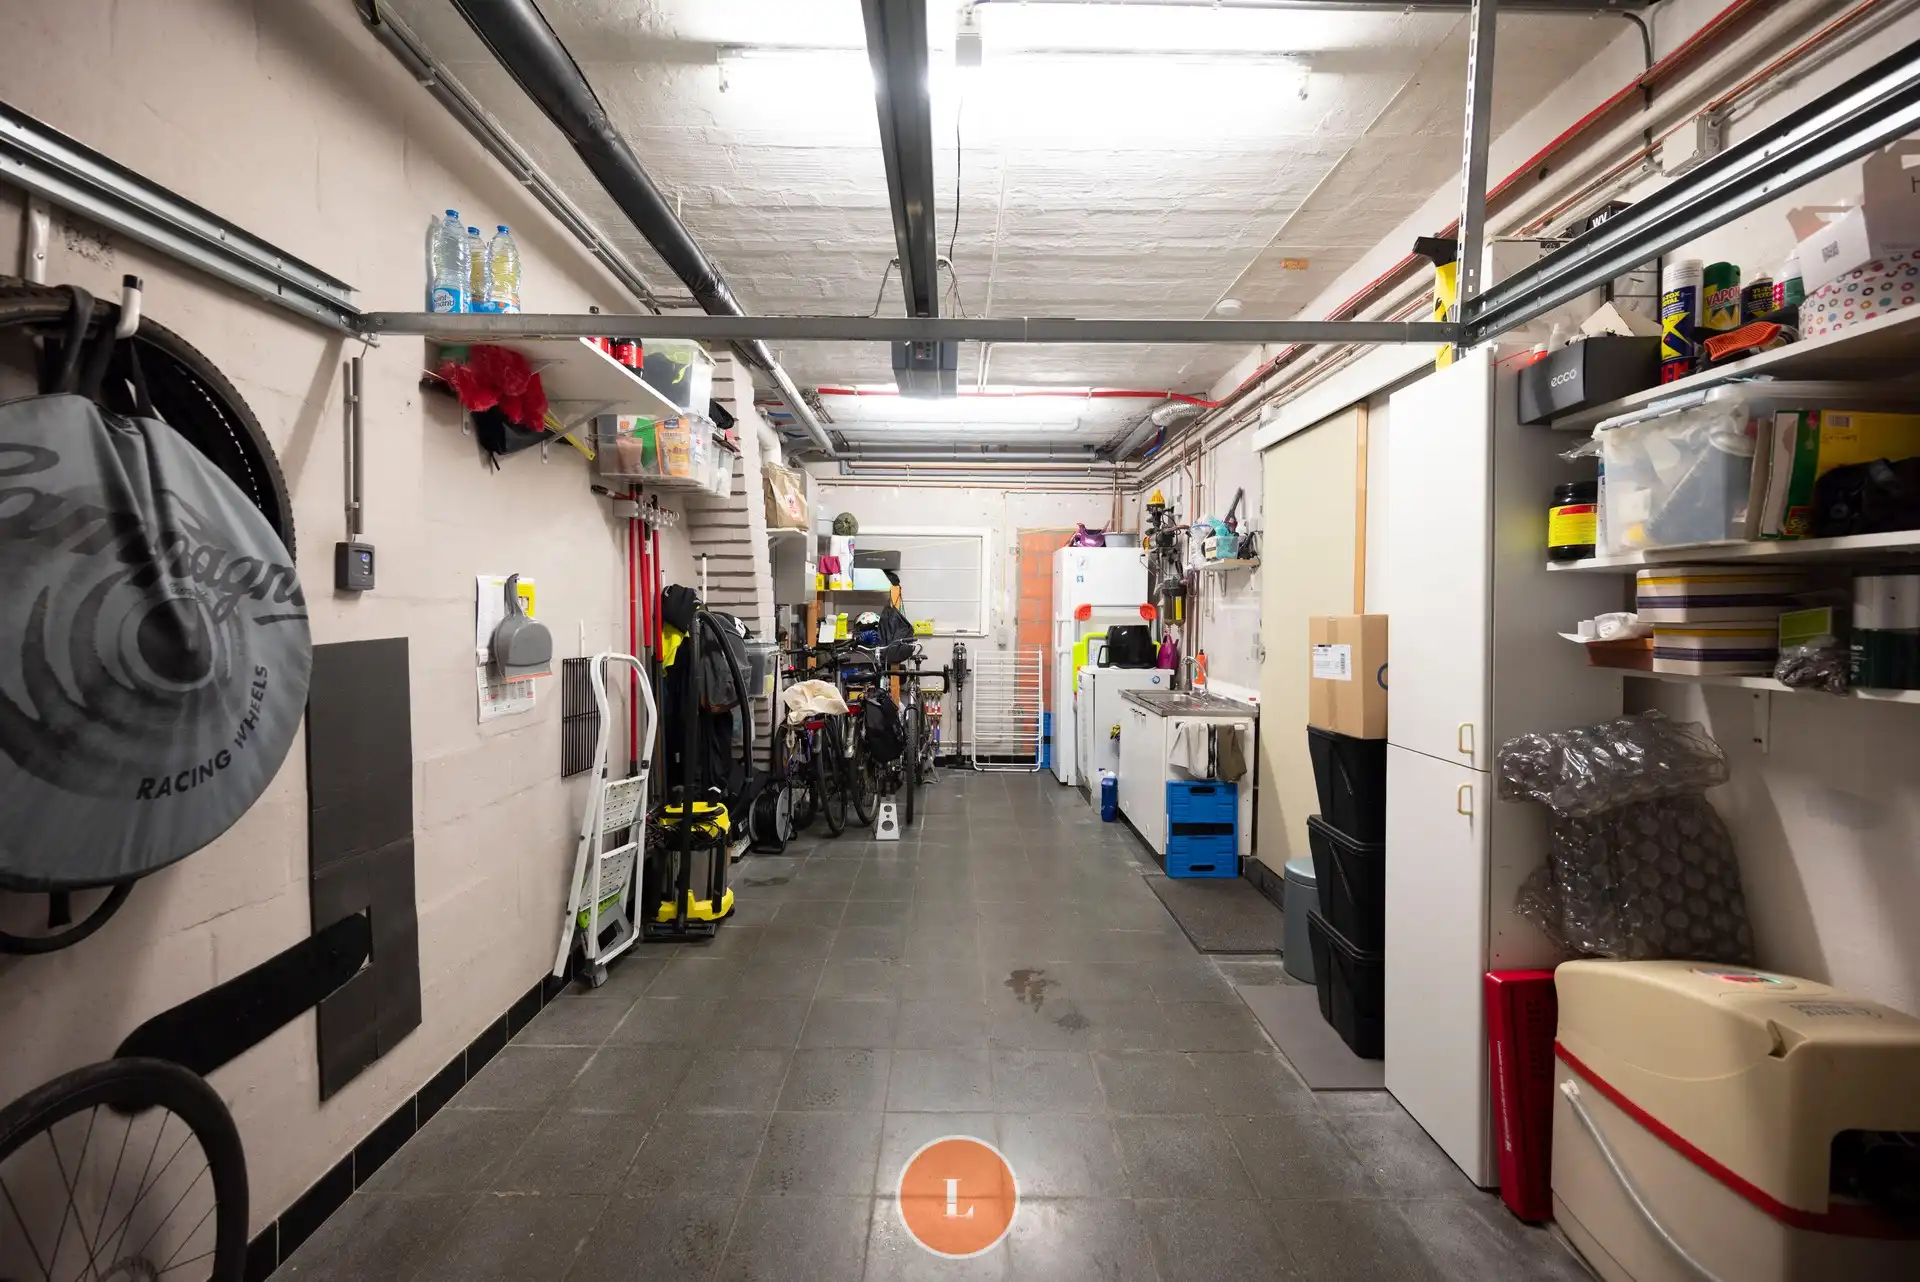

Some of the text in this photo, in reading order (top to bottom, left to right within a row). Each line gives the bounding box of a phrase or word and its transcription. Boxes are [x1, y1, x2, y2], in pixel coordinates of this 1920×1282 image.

[1551, 368, 1577, 387] ecco
[136, 665, 268, 800] RACING WHEELS
